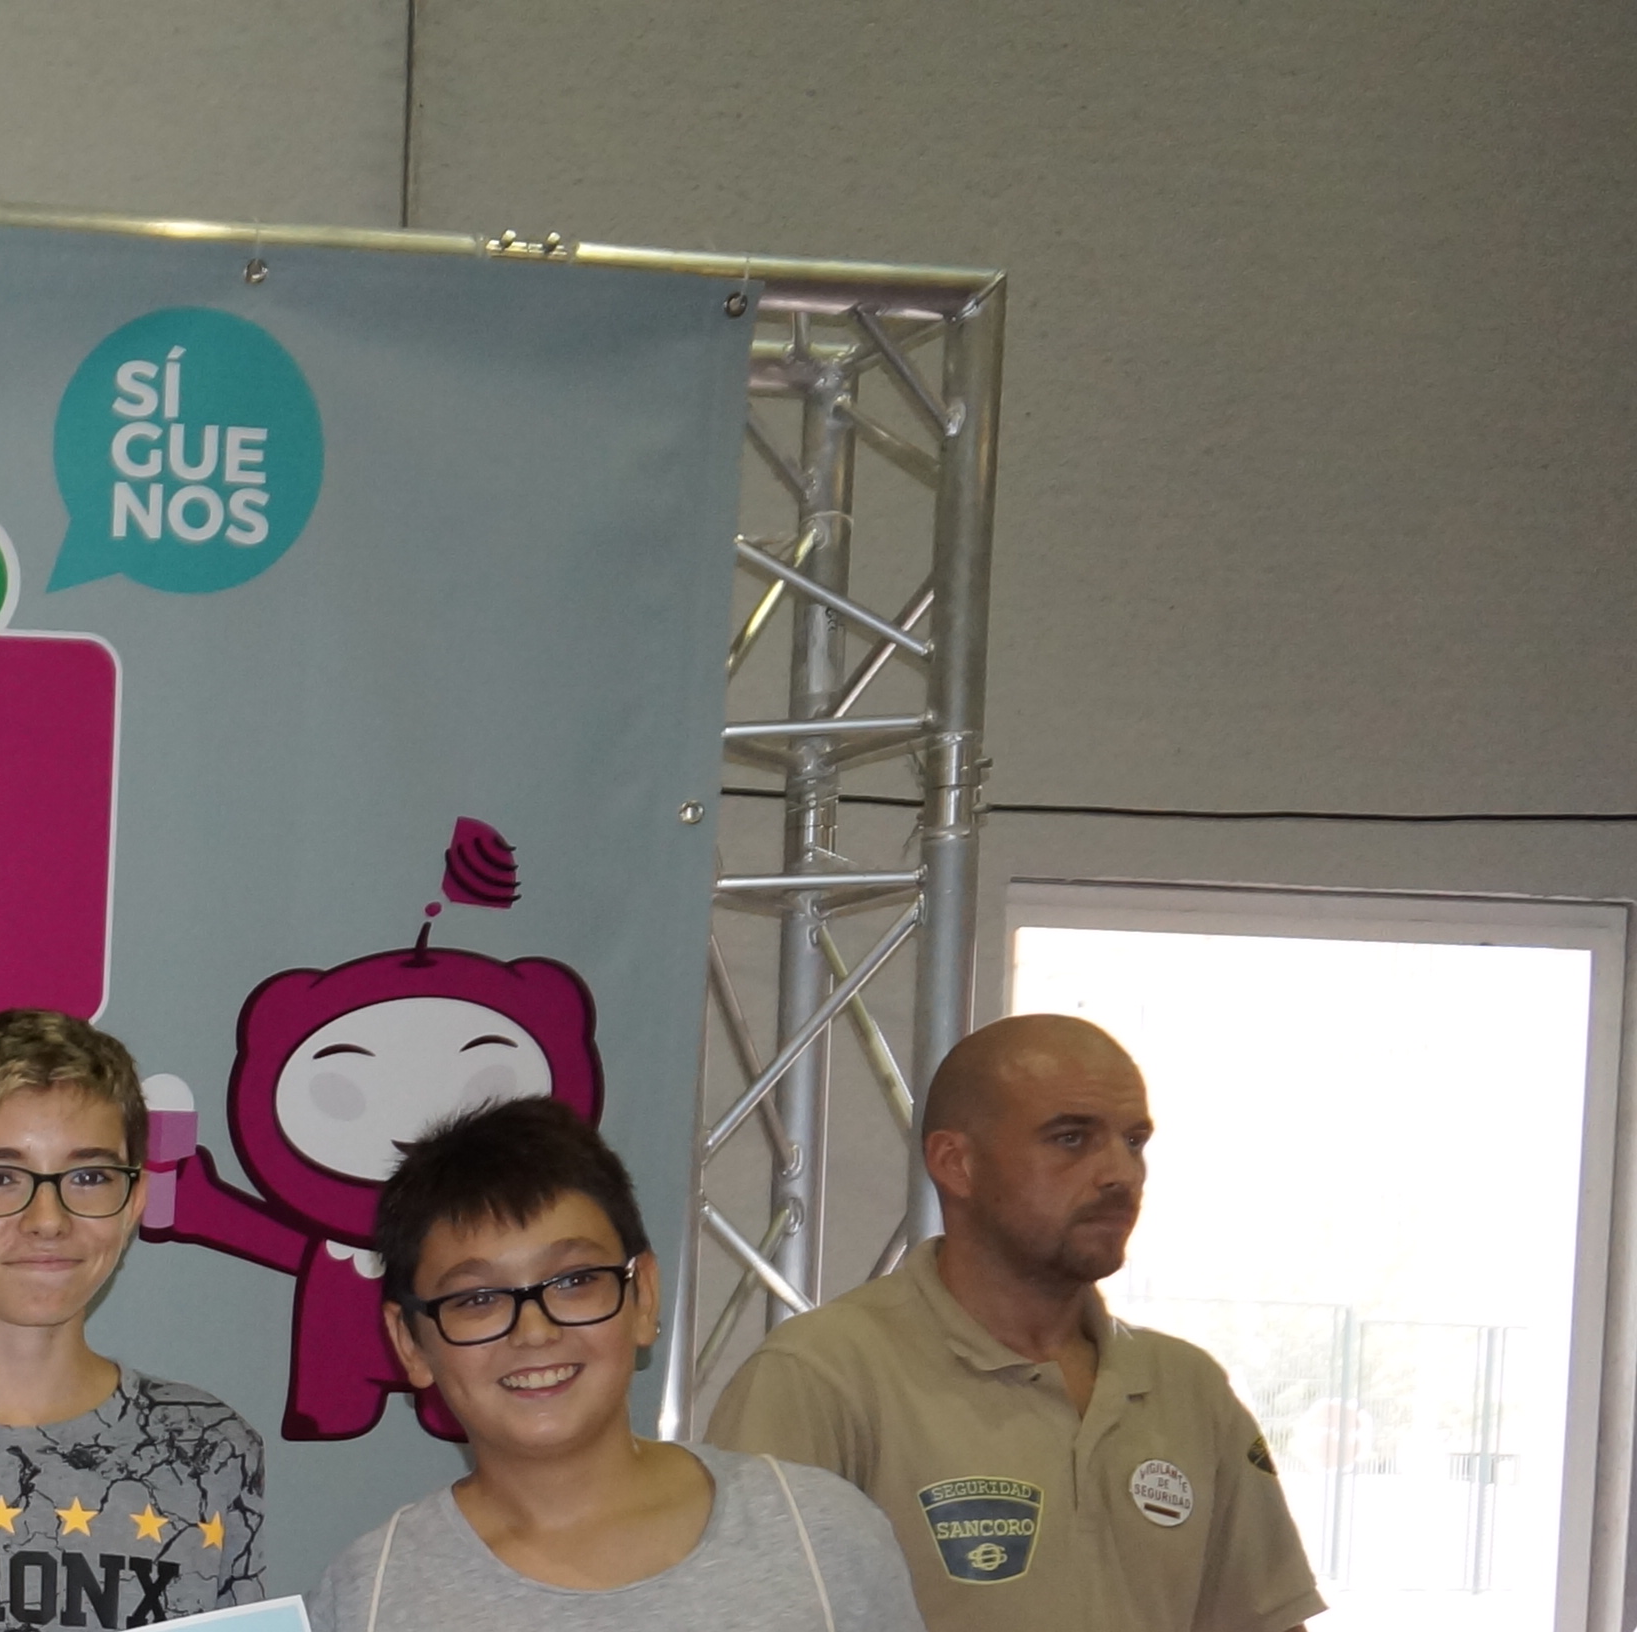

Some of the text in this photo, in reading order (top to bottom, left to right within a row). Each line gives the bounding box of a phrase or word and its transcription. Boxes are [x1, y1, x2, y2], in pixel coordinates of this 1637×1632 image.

[111, 344, 187, 419] SÍ
[110, 420, 268, 485] GUE
[111, 481, 271, 545] NOS
[931, 1480, 1032, 1502] SEGURIDAD
[1134, 1483, 1191, 1510] SEGURIDAD
[1157, 1477, 1170, 1489] DE
[936, 1518, 1035, 1539] SANCORO
